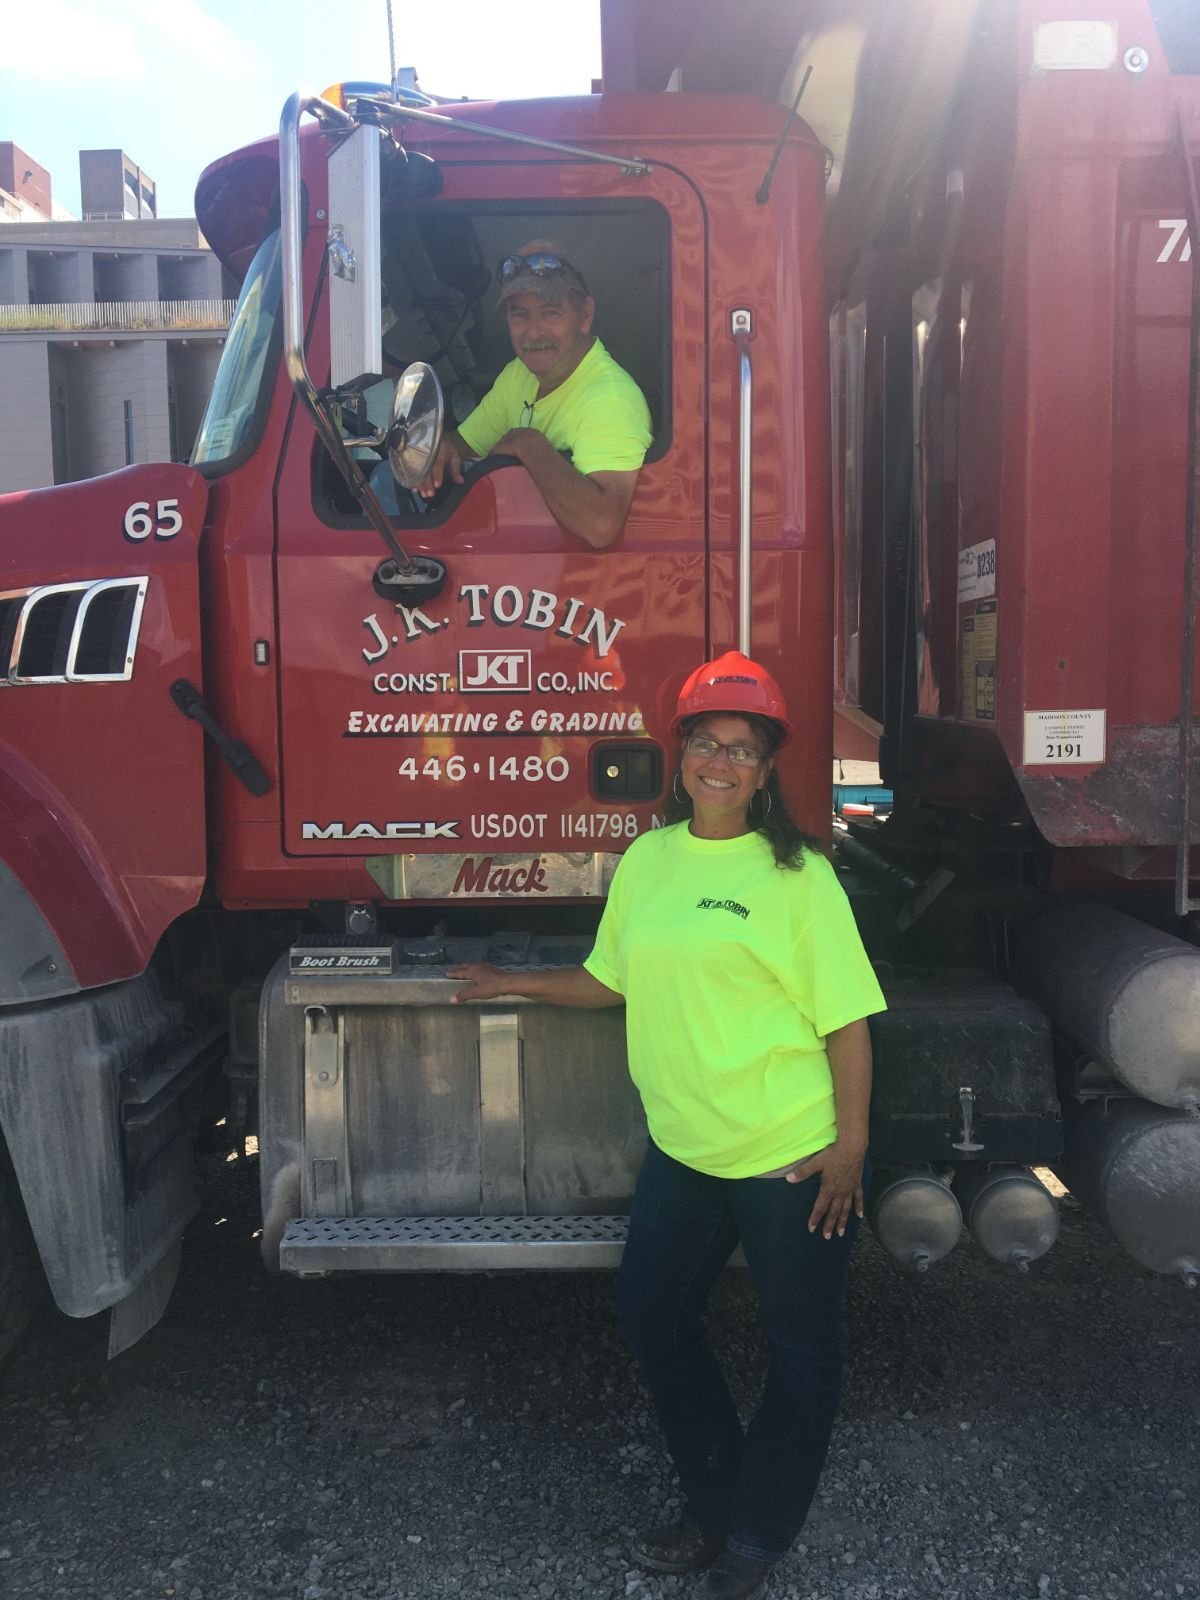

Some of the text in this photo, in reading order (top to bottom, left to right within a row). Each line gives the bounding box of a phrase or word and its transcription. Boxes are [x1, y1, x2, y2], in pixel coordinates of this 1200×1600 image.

[123, 498, 183, 542] 65
[977, 549, 995, 578] 8238
[459, 584, 626, 657] TOBIN
[373, 673, 455, 692] CONST.
[467, 655, 525, 686] JKT
[348, 709, 644, 733] EXCAVATING & GRADING
[1046, 743, 1081, 758] 2191
[302, 822, 462, 839] MACK
[470, 814, 548, 838] USDOT
[561, 813, 638, 838] 1141798
[452, 857, 549, 893] Mack
[299, 956, 380, 967] Boot Brush
